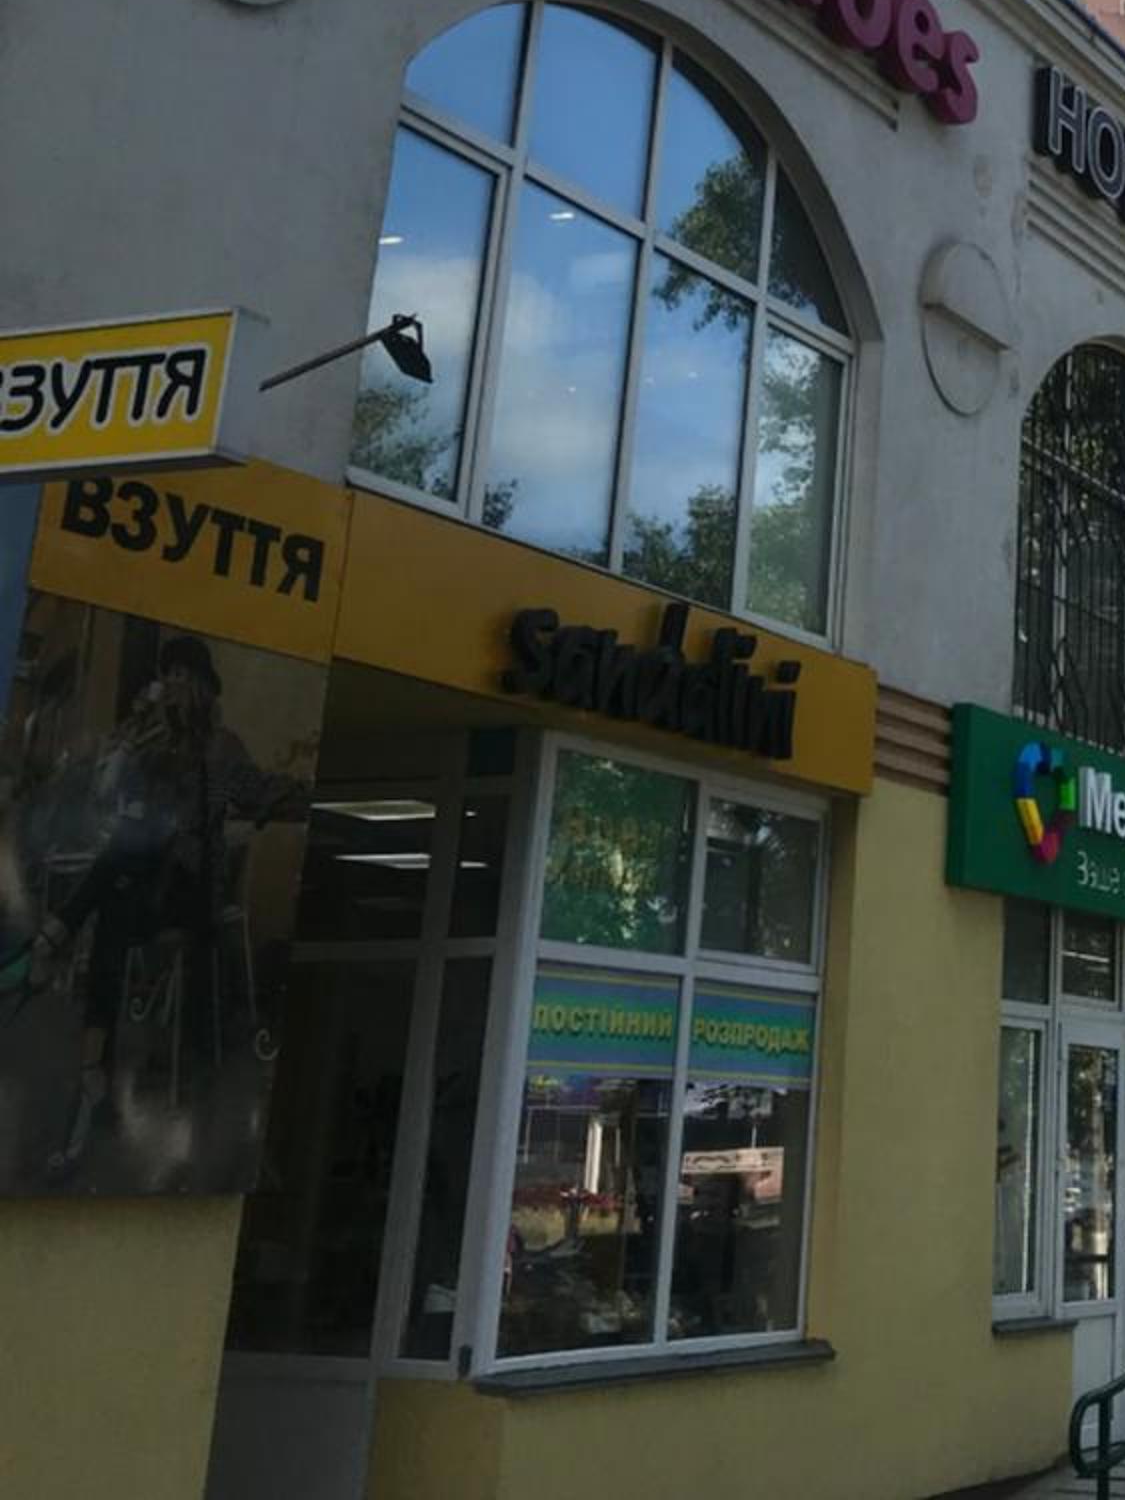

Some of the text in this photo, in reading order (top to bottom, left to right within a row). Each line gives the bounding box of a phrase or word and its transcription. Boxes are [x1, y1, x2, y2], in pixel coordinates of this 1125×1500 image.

[0, 348, 207, 432] ЗУТТЯ
[60, 475, 326, 603] ВЗУТТЯ
[693, 1014, 809, 1052] РОЗПРОДАЖ
